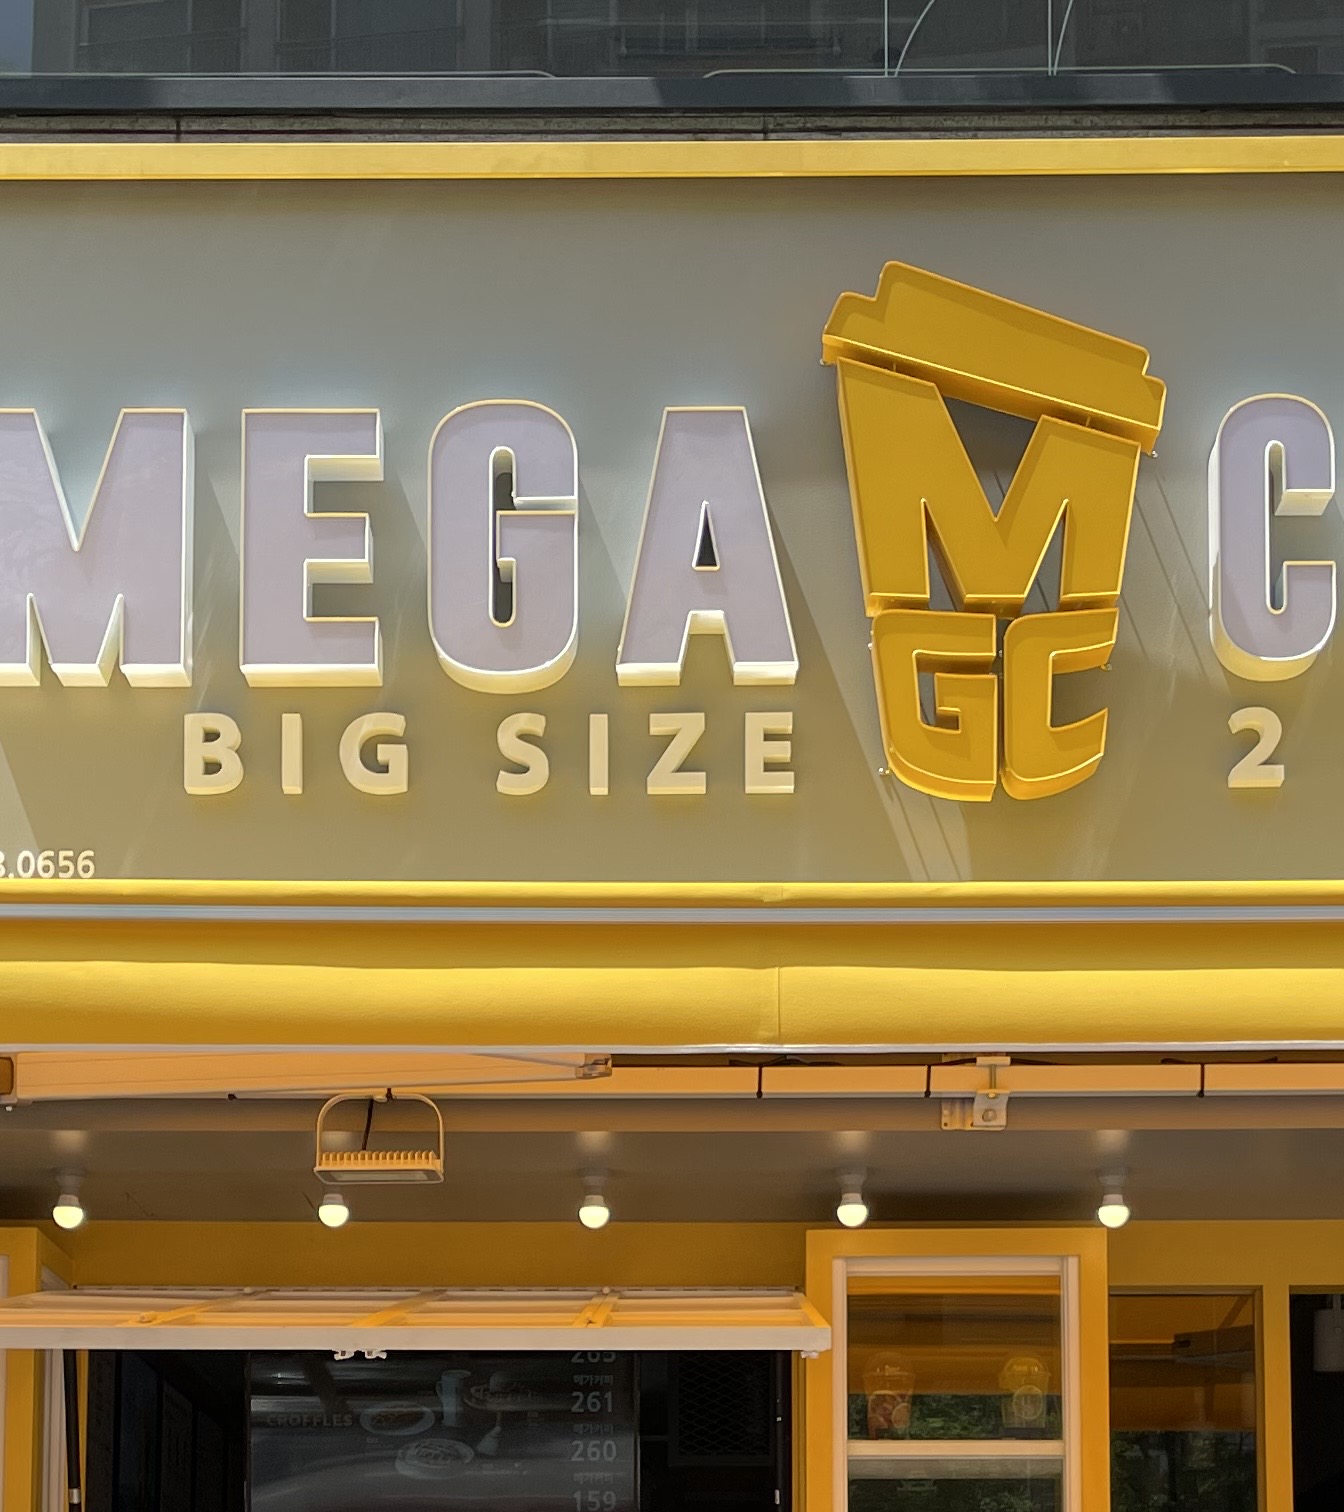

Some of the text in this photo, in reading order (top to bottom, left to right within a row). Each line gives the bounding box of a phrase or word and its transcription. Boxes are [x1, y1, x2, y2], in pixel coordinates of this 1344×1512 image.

[184, 712, 409, 796] BIG
[496, 712, 796, 796] SIZE
[1227, 705, 1287, 789] 2
[571, 1391, 614, 1413] 261
[571, 1440, 618, 1463] 260
[573, 1490, 618, 1512] 159
